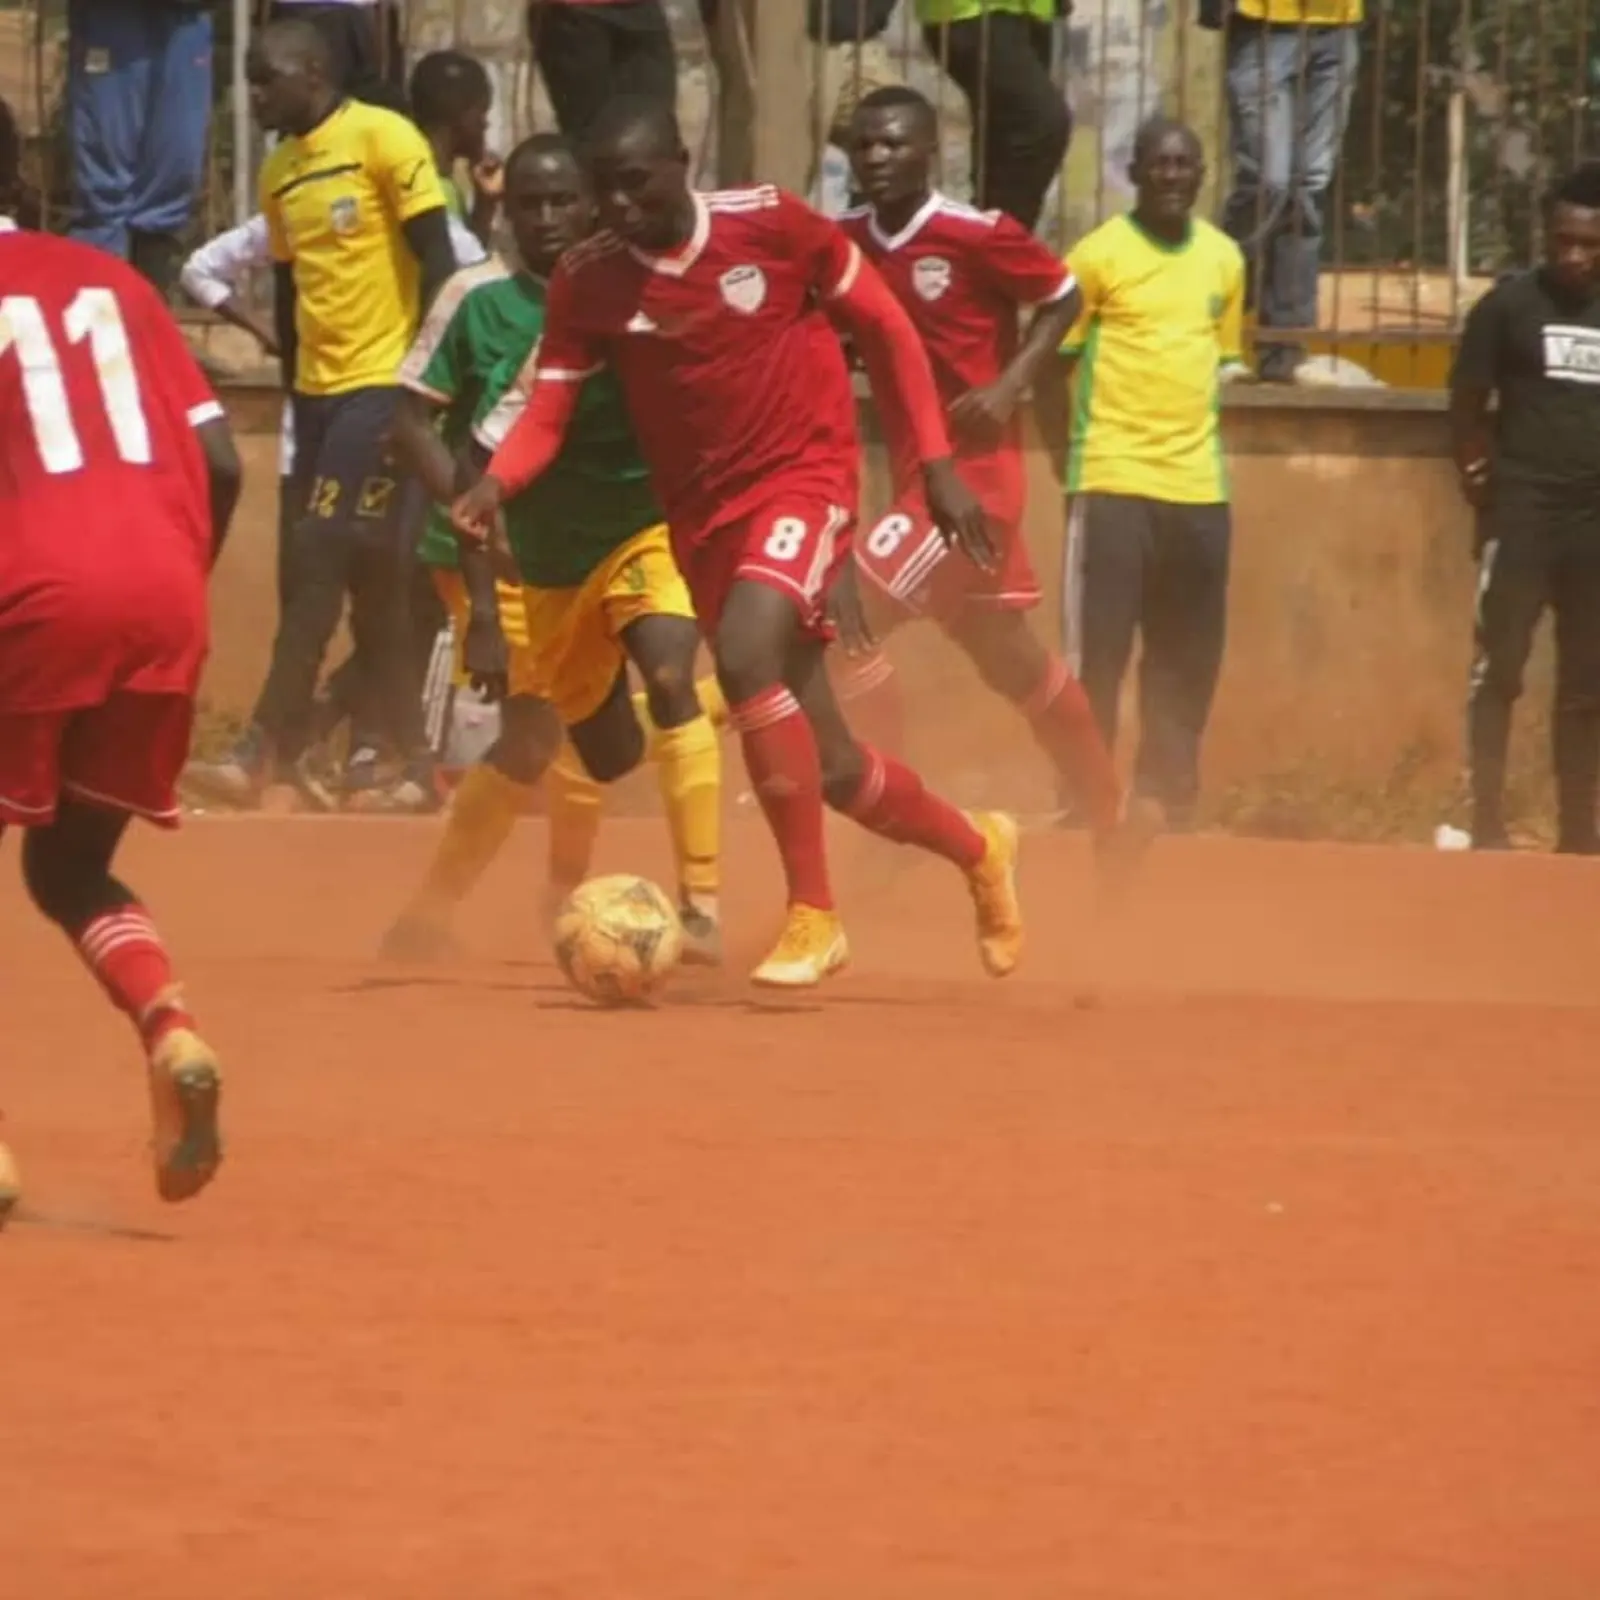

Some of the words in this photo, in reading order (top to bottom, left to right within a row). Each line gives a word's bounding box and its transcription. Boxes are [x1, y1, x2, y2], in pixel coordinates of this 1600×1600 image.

[0, 286, 153, 474] 11
[764, 517, 807, 561] 8
[867, 513, 912, 558] 6
